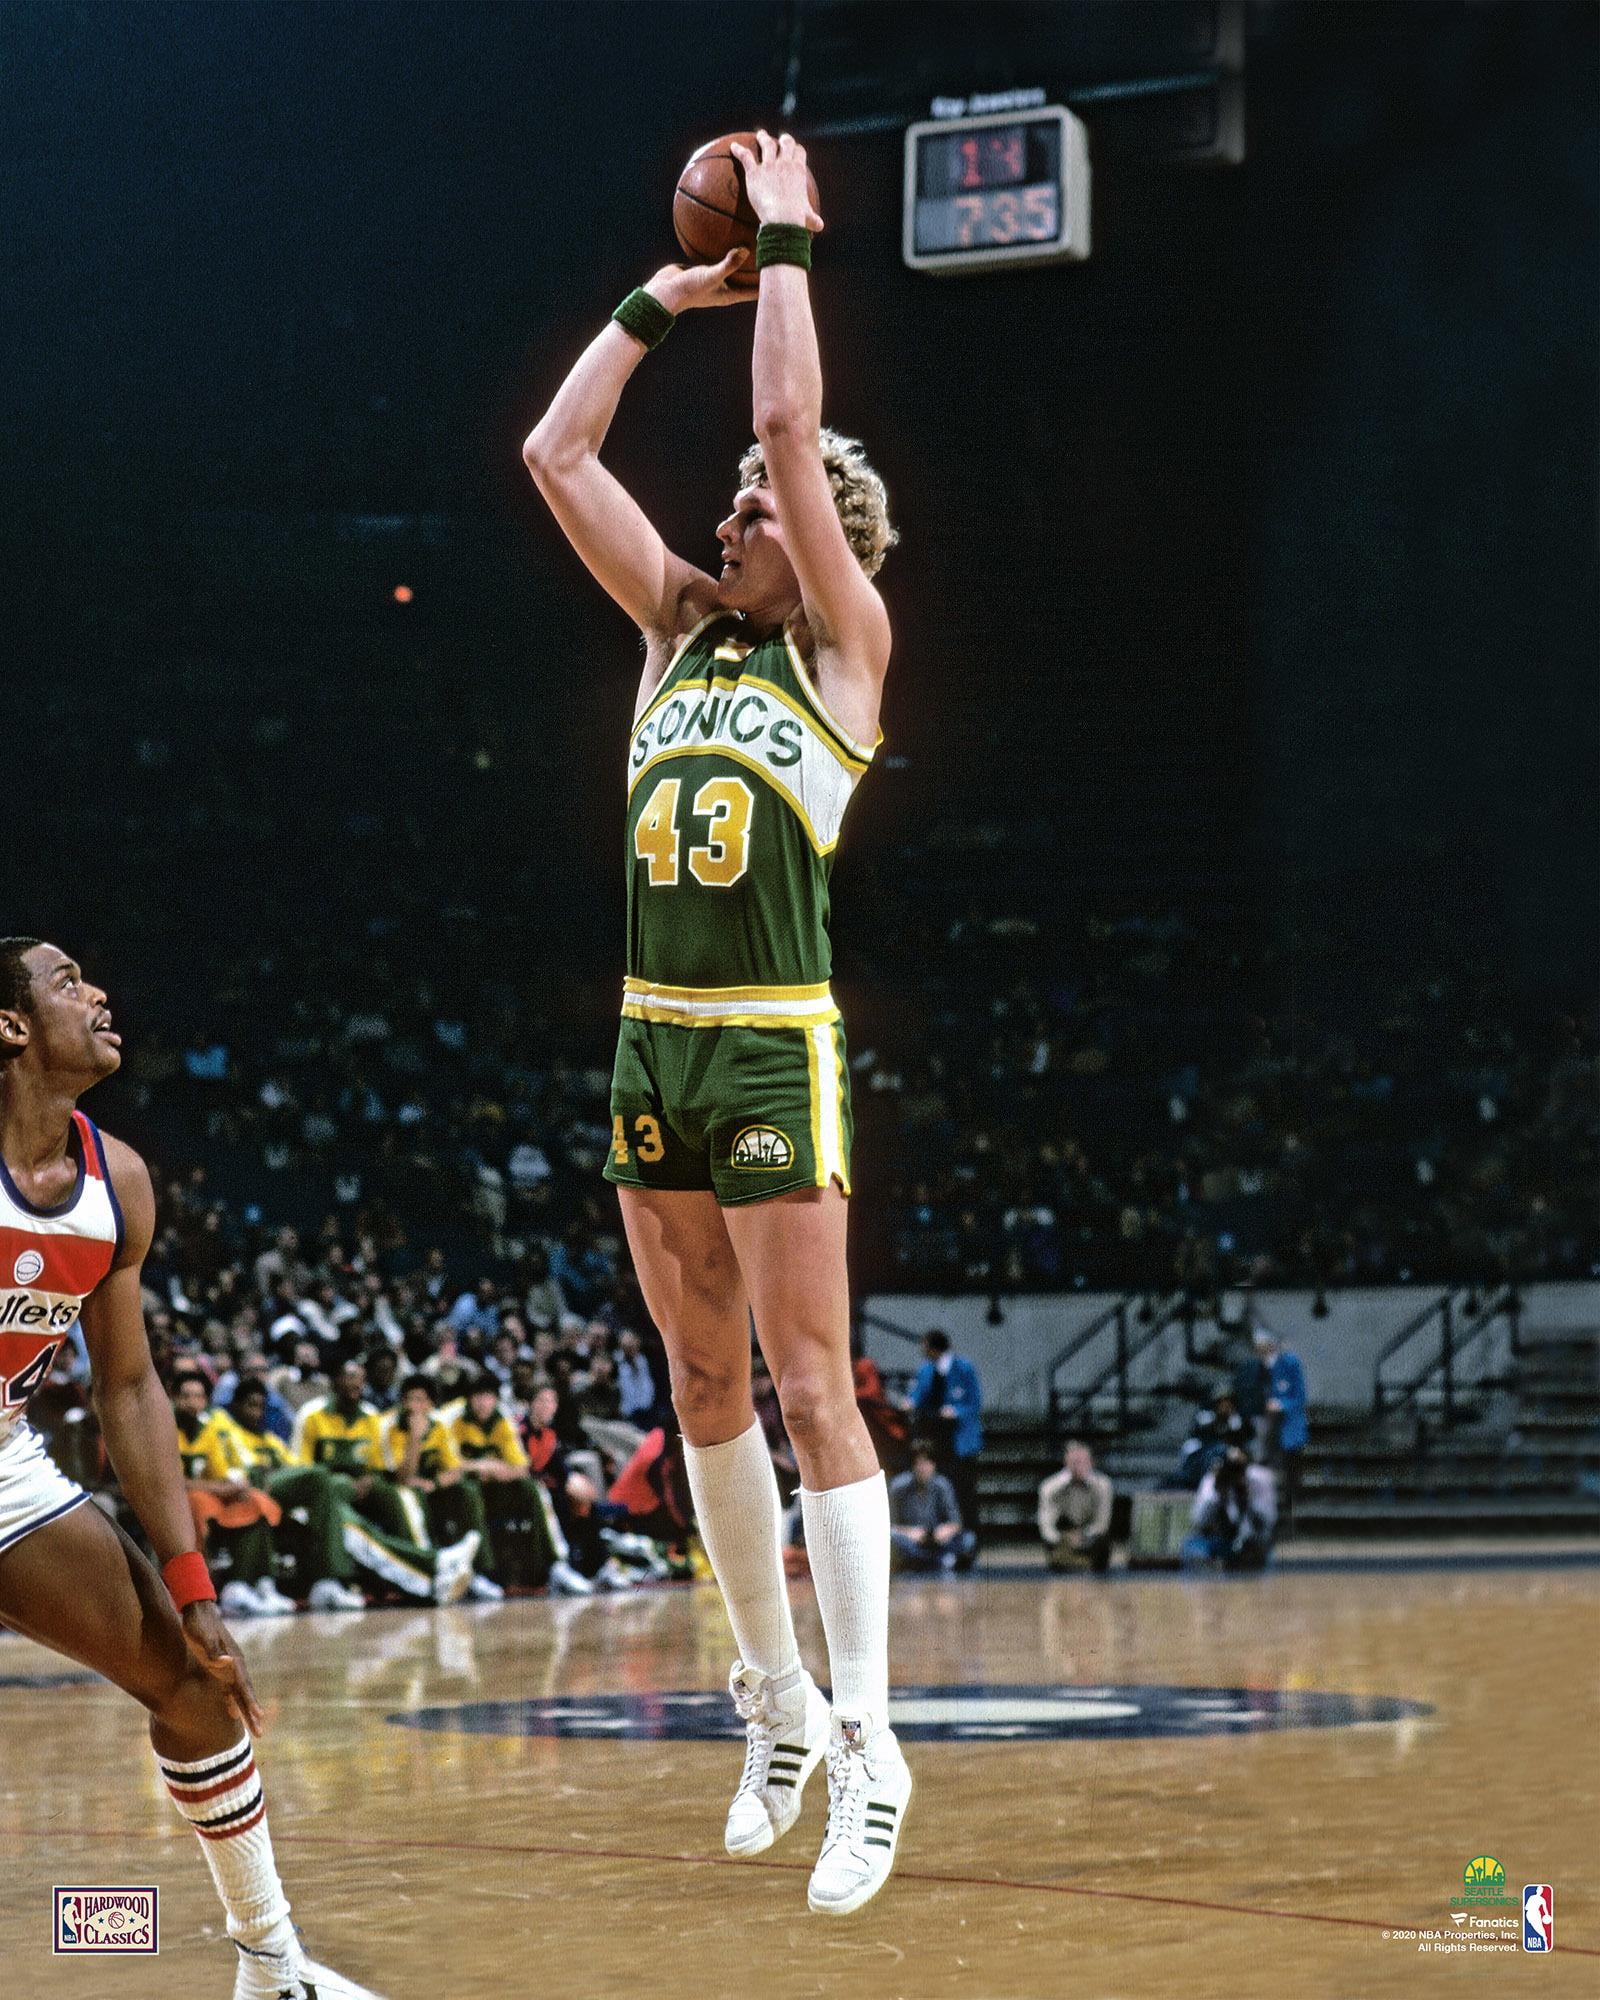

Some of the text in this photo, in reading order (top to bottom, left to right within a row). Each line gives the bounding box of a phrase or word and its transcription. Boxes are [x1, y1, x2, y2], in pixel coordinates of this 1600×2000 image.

[632, 695, 803, 768] SONICS
[634, 777, 754, 887] 43
[0, 1295, 79, 1327] llets
